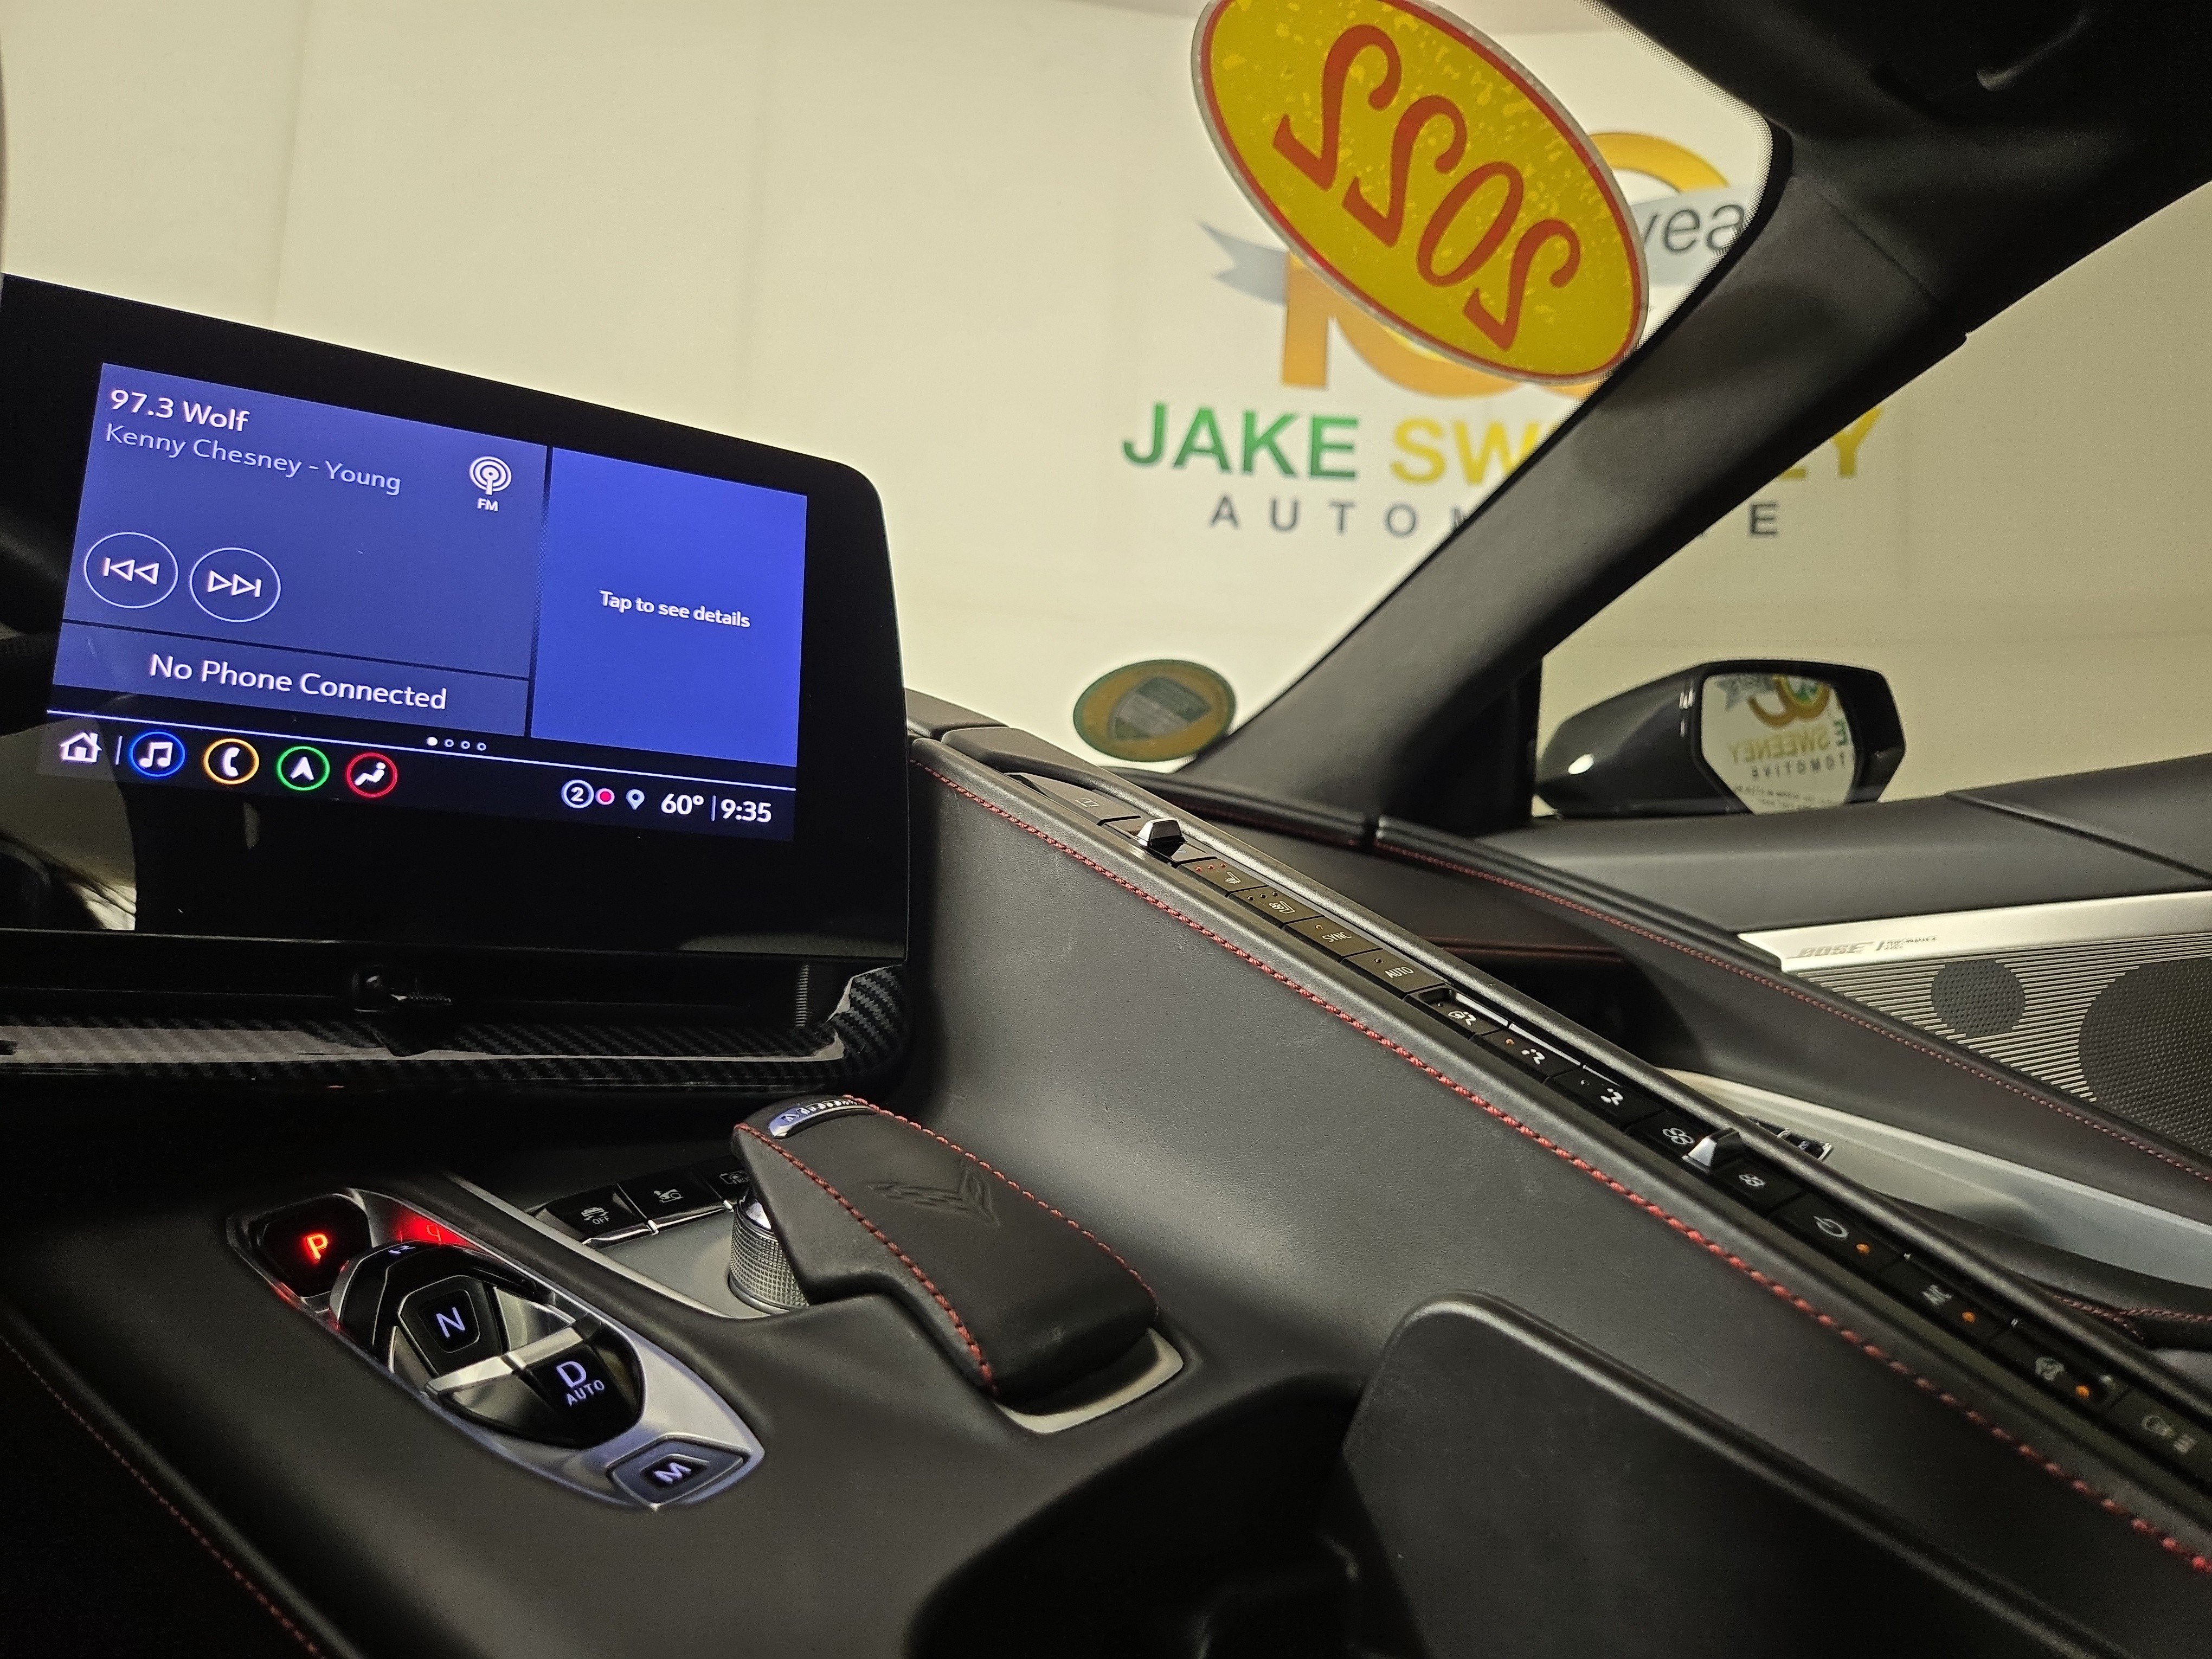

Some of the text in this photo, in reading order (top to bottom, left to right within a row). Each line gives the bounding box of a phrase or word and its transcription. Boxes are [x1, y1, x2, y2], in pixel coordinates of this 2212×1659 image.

[110, 389, 250, 432] 97.3 Wolf
[1122, 402, 1360, 480] JAKE
[106, 423, 187, 459] Kenny
[193, 438, 303, 478] Chesney
[325, 460, 402, 496] Young
[477, 498, 499, 512] FM
[600, 590, 751, 628] Tap to see details
[150, 653, 447, 710] No Phone Connected
[661, 794, 704, 815] 60°
[721, 799, 773, 823] 9:35
[1322, 931, 1352, 942] SYNC
[1797, 942, 1874, 957] BOSE
[1384, 966, 1414, 979] AUTO
[592, 1216, 610, 1225] OFF
[306, 1232, 329, 1262] P
[436, 1306, 466, 1341] N
[556, 1360, 587, 1388] D
[565, 1379, 606, 1407] AUTO
[654, 1462, 692, 1484] M
